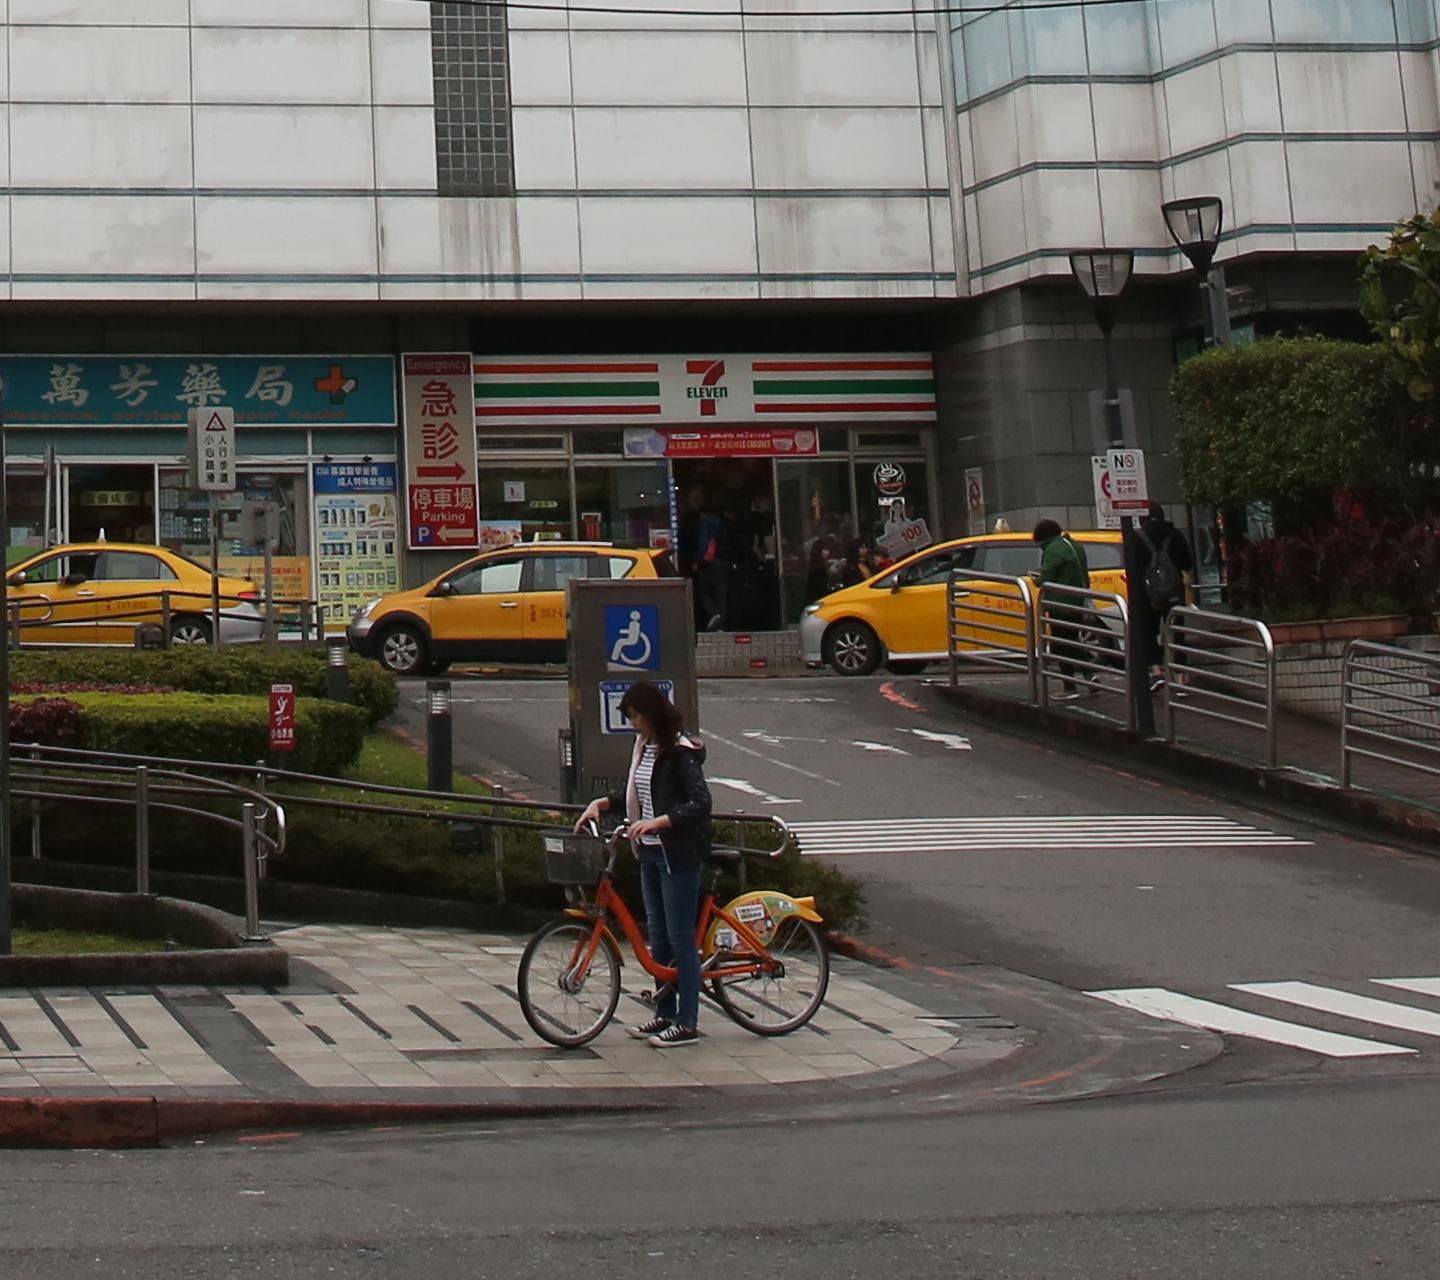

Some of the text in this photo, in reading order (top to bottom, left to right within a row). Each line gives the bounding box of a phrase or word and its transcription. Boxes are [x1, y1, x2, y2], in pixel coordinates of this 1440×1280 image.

[406, 357, 468, 373] Emergency
[41, 362, 294, 407] 萬芳藥局
[421, 380, 458, 460] 急診
[413, 488, 474, 510] 停車場
[422, 511, 466, 524] Parking
